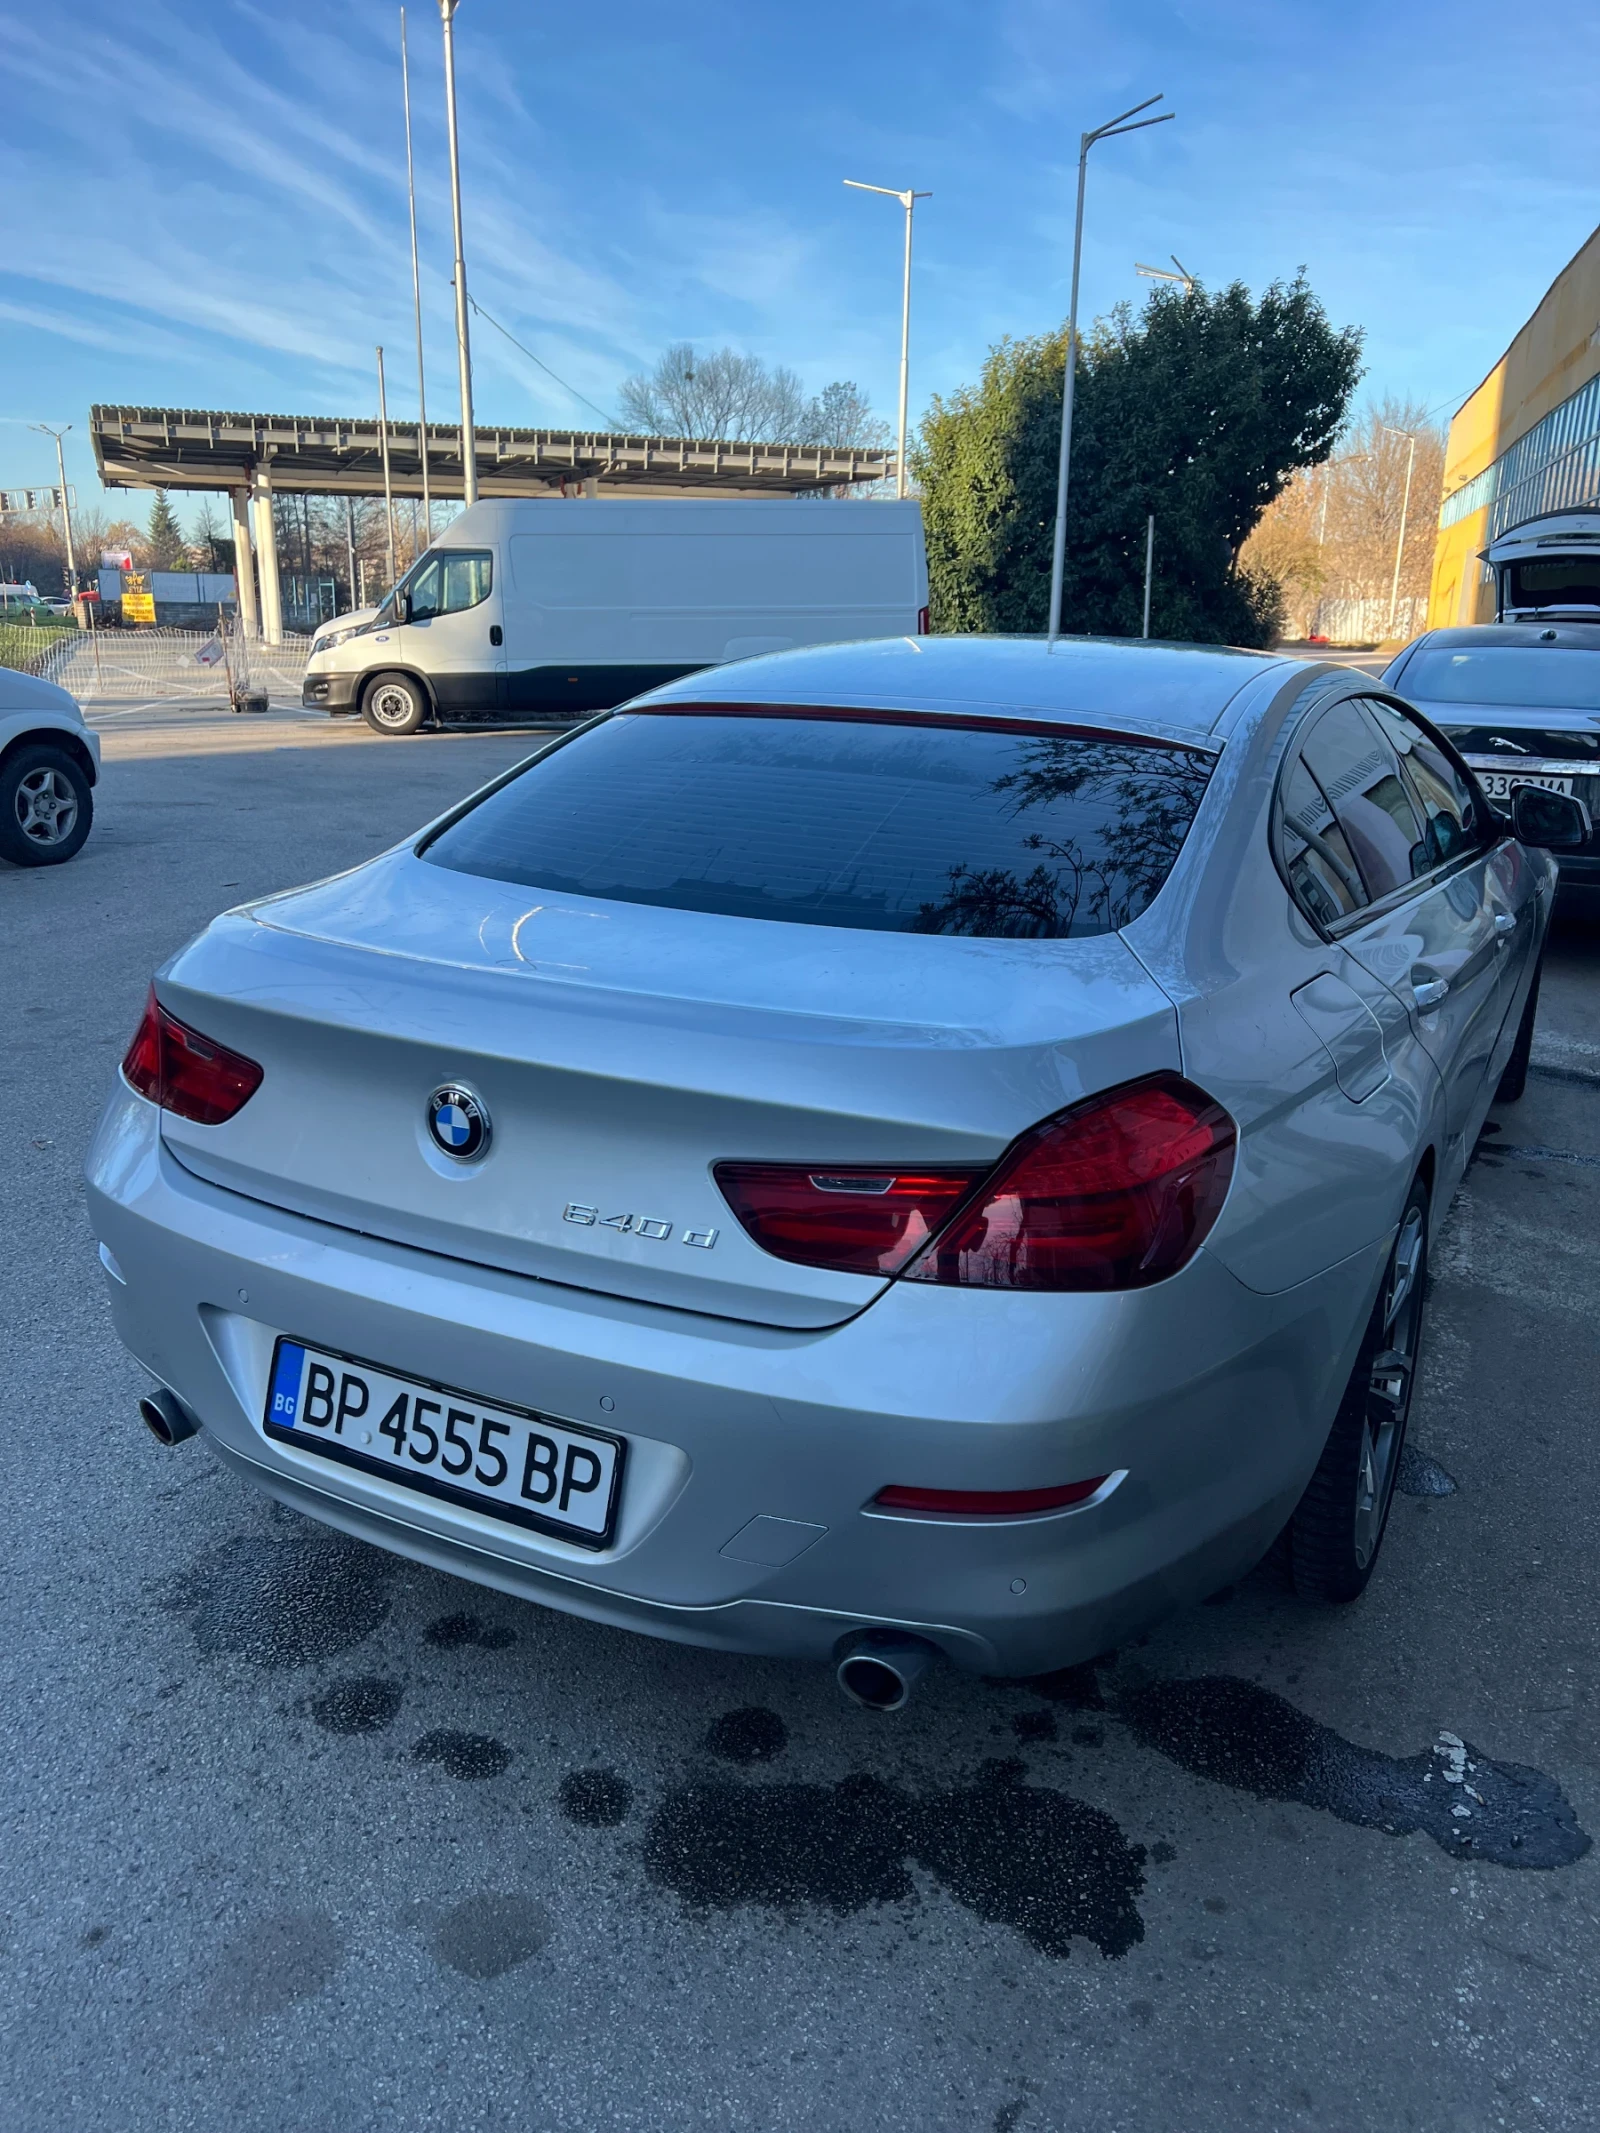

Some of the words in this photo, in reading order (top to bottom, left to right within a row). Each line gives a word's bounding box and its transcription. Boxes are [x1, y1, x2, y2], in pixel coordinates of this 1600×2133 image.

[1485, 776, 1535, 796] 33
[431, 1093, 478, 1119] BMW
[274, 1392, 295, 1415] BG
[302, 1362, 370, 1435] BP
[379, 1392, 511, 1487] 4555
[520, 1432, 602, 1511] BP
